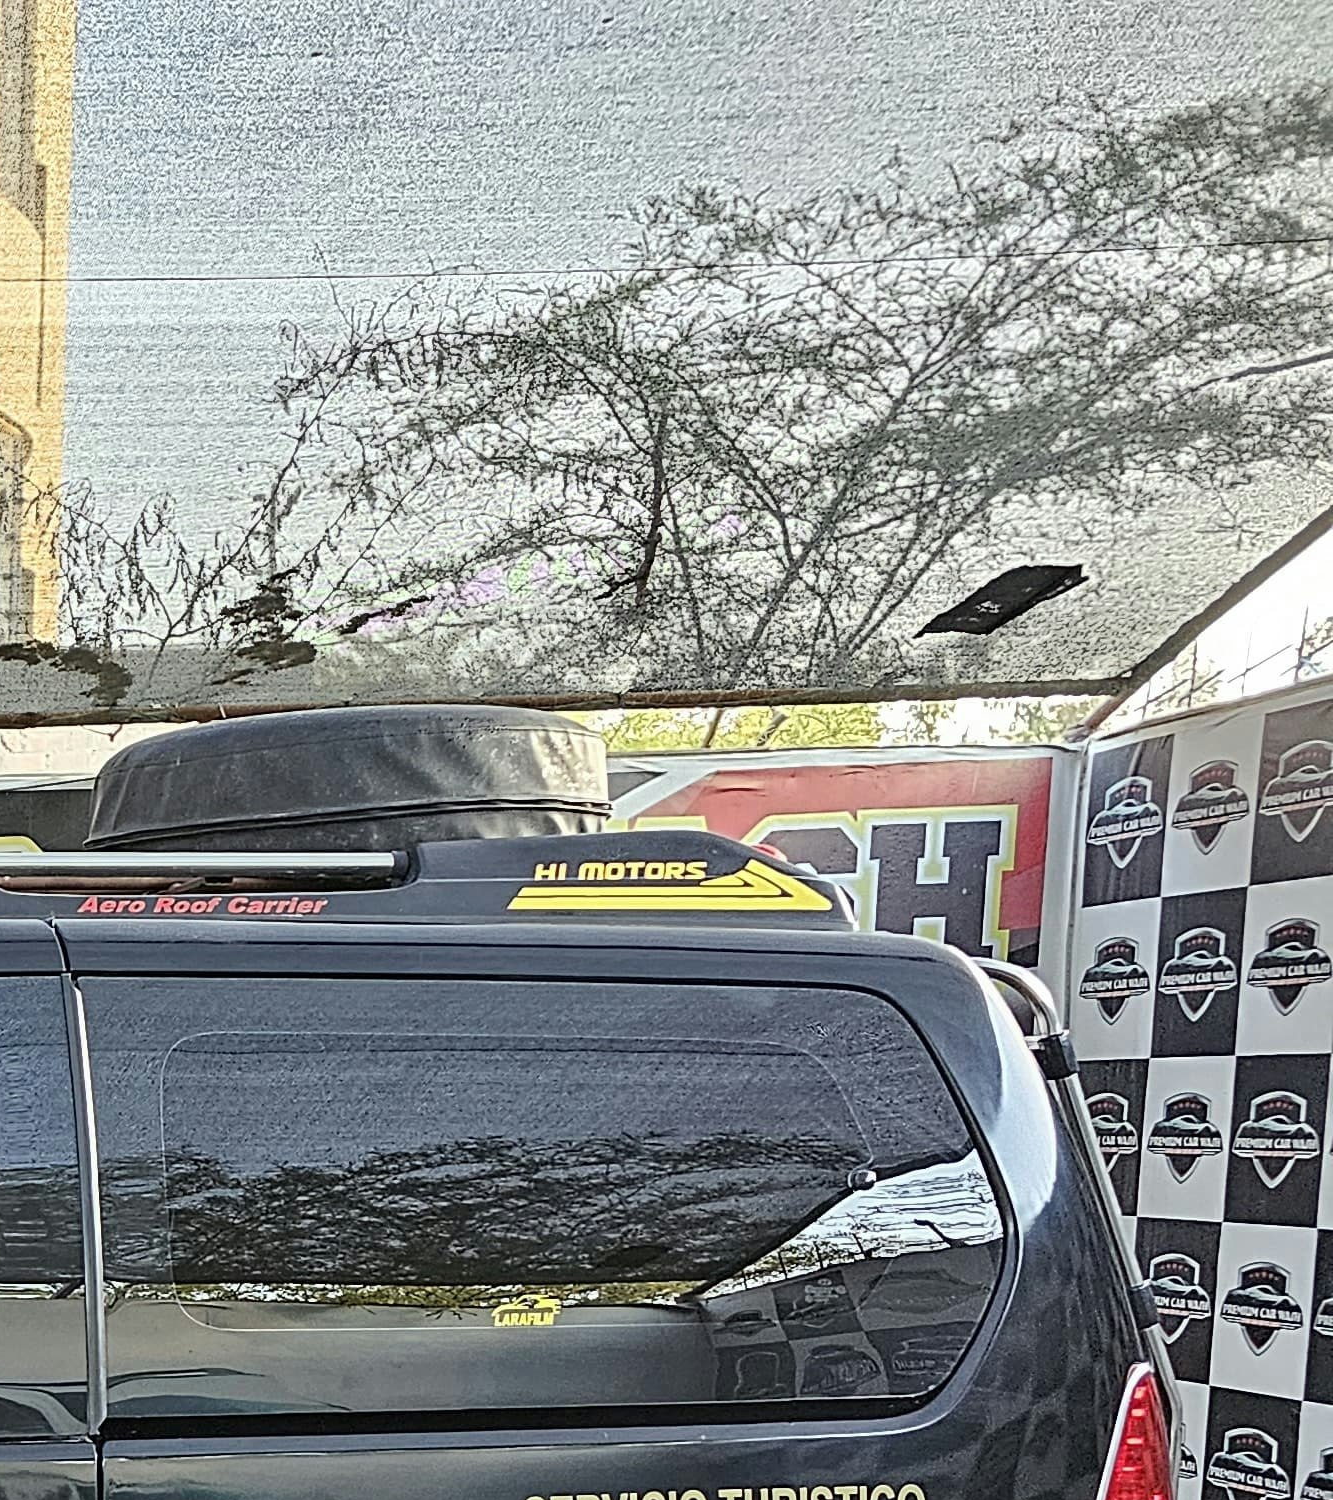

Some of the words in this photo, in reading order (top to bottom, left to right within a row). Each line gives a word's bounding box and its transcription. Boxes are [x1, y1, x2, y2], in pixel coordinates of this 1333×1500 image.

[1302, 787, 1322, 800] CAR
[534, 862, 568, 881] HI
[578, 861, 708, 881] MOTORS
[77, 896, 146, 914] Aero
[153, 897, 222, 914] Roof
[227, 896, 329, 914] Carrier
[1287, 964, 1306, 977] CAR
[1113, 978, 1128, 989] CAR
[1196, 971, 1213, 984] CAR
[1101, 1135, 1118, 1147] CAR
[1183, 1136, 1199, 1148] CAR
[1274, 1137, 1291, 1149] CAR
[1170, 1297, 1186, 1309] CAR
[493, 1310, 555, 1327] LARAFILM
[1259, 1307, 1277, 1320] CAR
[1246, 1473, 1264, 1486] CAR
